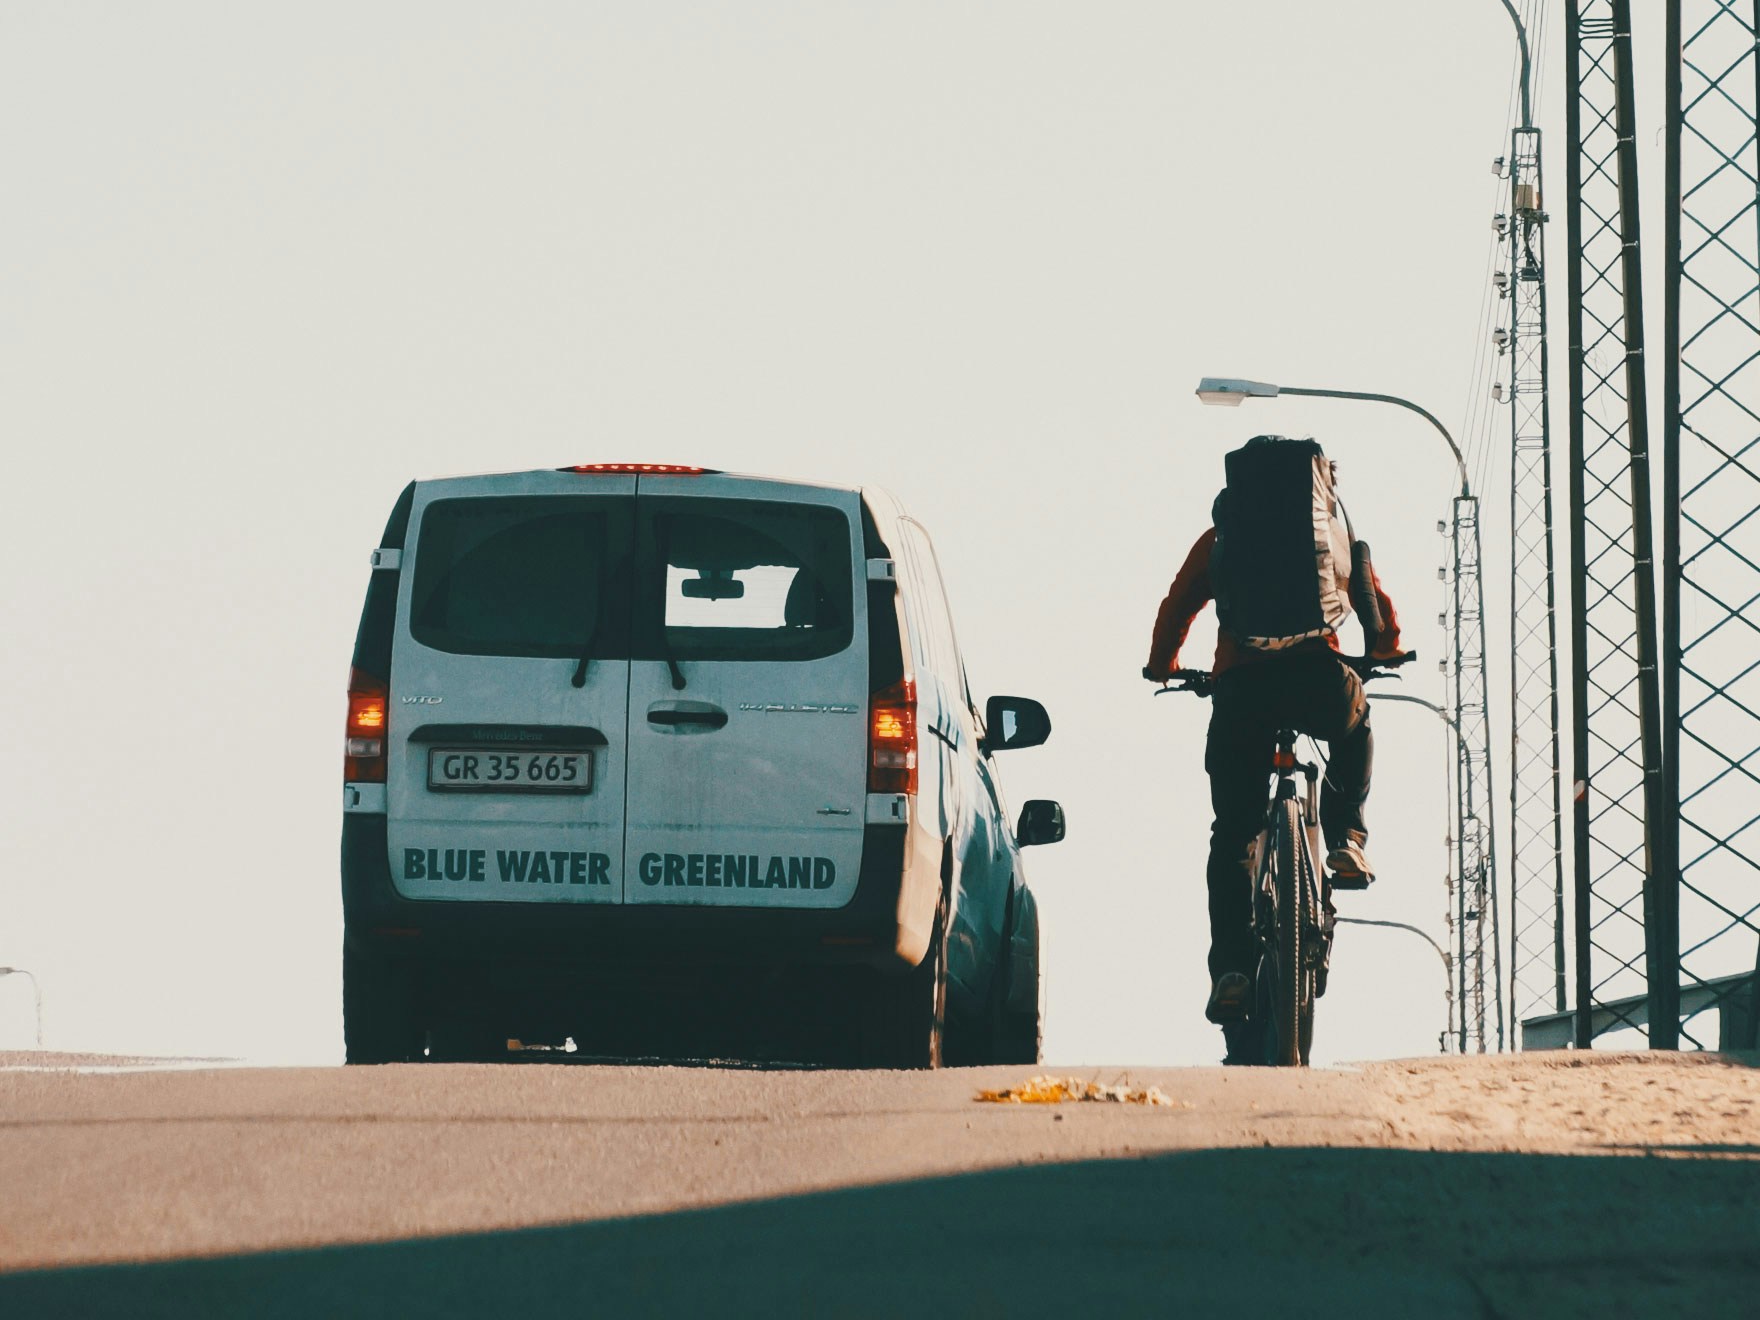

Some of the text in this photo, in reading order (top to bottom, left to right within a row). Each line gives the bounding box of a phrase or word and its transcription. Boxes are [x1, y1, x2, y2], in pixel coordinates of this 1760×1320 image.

[403, 695, 443, 705] VITO
[443, 755, 577, 781] GR 35 665
[404, 848, 836, 889] BLUE WATER GREENLAND
